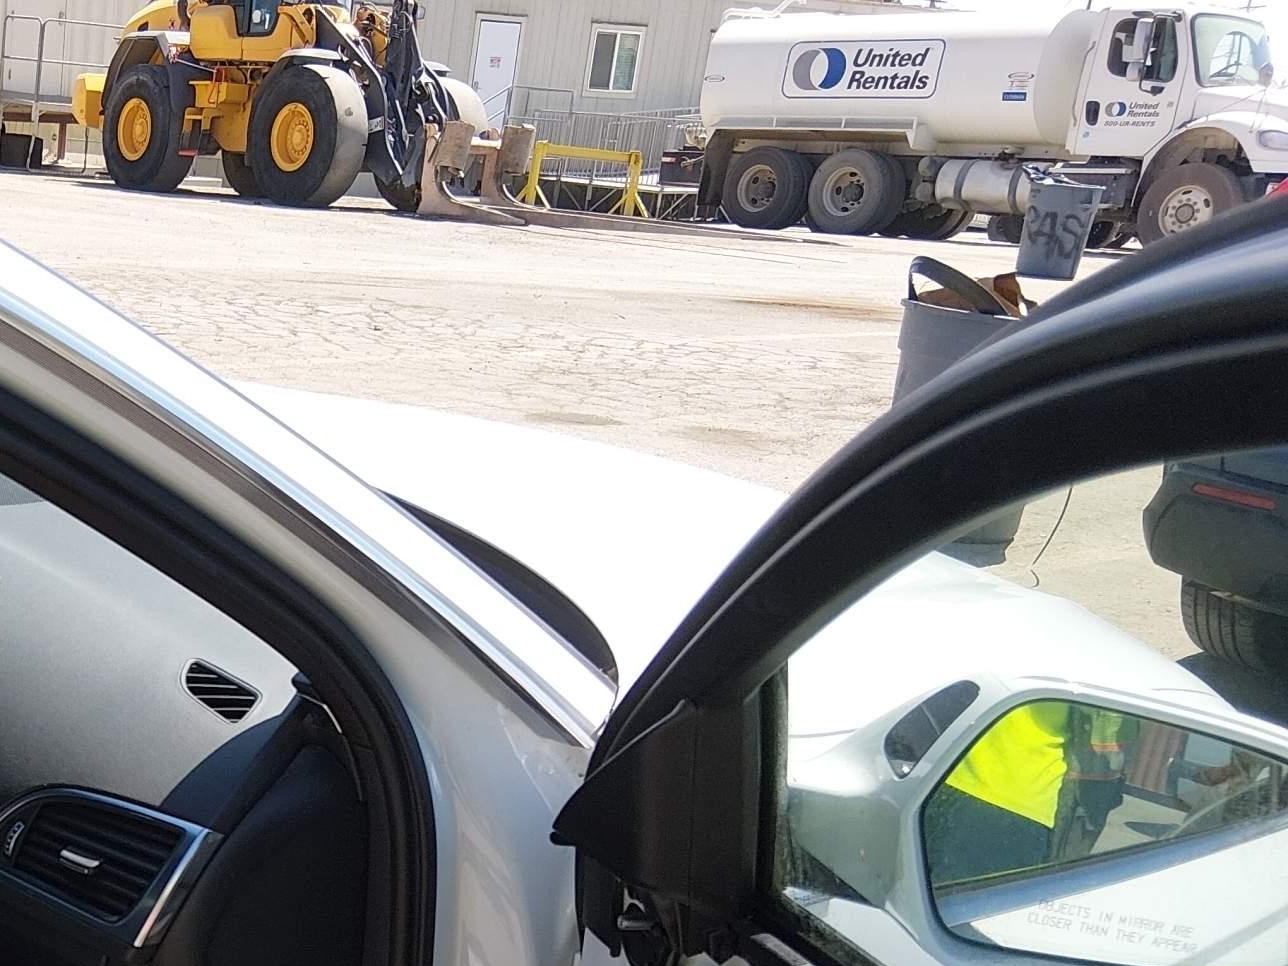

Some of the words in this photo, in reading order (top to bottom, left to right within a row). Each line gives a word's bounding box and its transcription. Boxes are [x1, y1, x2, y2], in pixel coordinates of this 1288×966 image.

[852, 47, 931, 68] United
[846, 70, 930, 90] Rentals
[1126, 110, 1160, 118] Rentals
[1128, 102, 1160, 110] United
[1037, 899, 1091, 920] OBJECTS
[1098, 911, 1113, 923] IN
[1118, 915, 1165, 934] MIRROR
[1170, 925, 1196, 939] ARE
[1027, 911, 1073, 931] CLOSER
[1079, 921, 1110, 937] THAN
[1115, 928, 1145, 945] THEY
[1151, 936, 1199, 953] APPEAR
